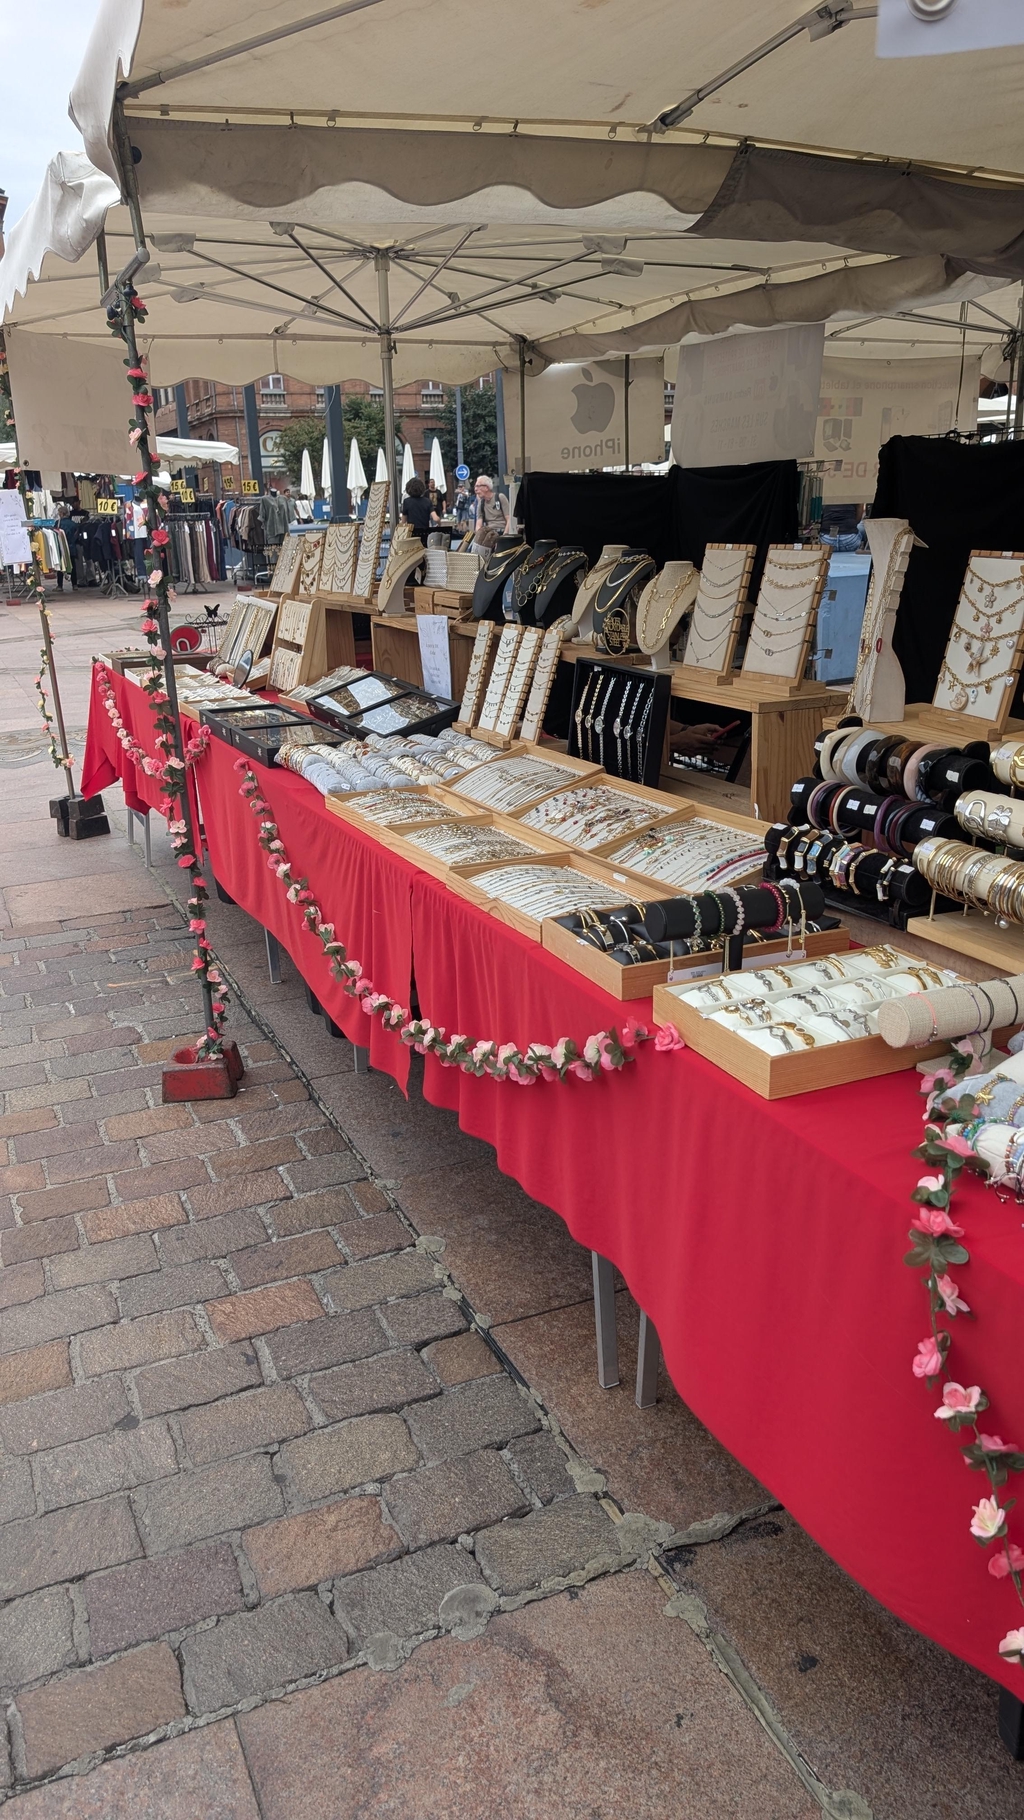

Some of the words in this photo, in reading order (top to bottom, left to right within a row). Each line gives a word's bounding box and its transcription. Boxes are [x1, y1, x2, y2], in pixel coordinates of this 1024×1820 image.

[171, 481, 179, 491] 15
[242, 481, 250, 491] 15
[252, 481, 257, 491] €
[99, 500, 109, 511] 10
[111, 501, 117, 512] €
